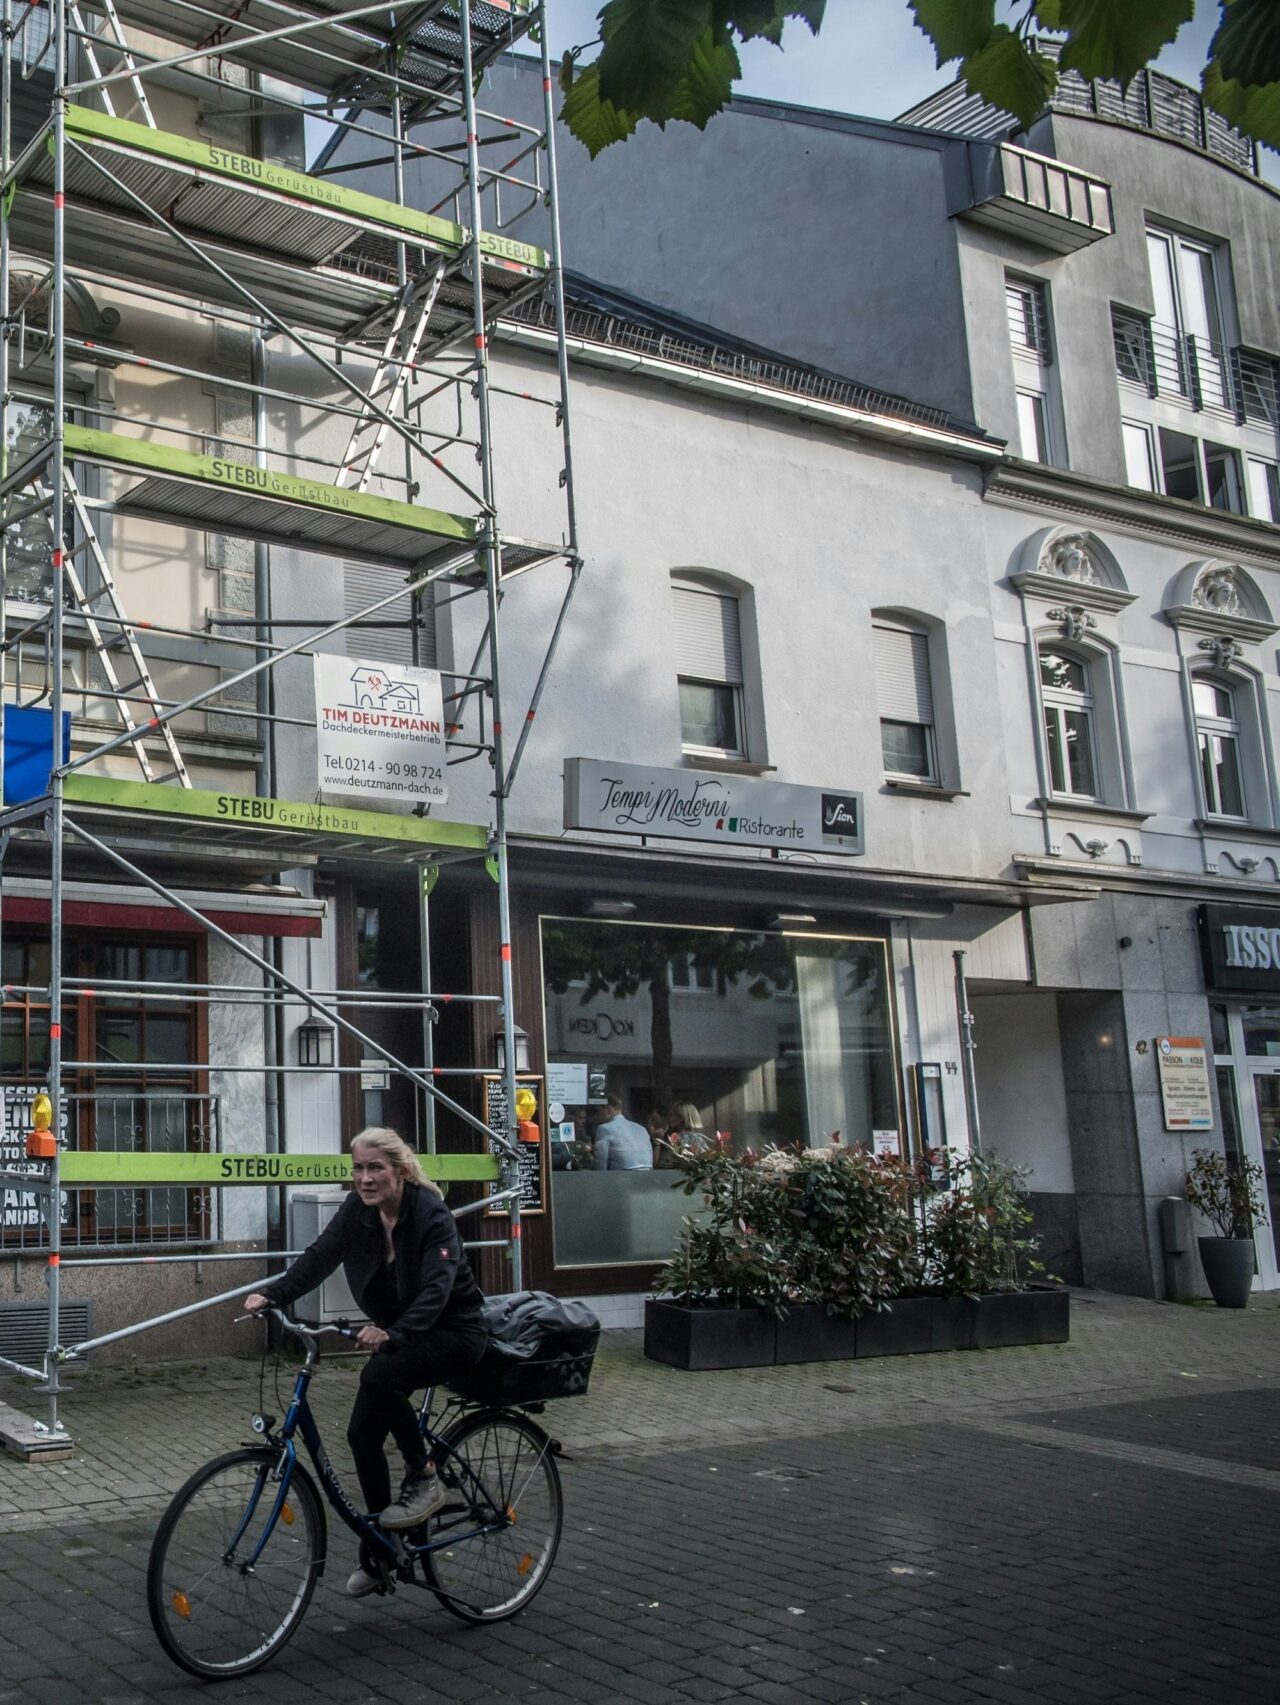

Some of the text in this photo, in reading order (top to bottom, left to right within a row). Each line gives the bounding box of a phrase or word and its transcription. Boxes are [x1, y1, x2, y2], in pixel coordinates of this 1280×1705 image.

[209, 149, 341, 203] STEBU Gerüstbau
[488, 236, 531, 262] STEBU
[212, 461, 267, 488] STEBU
[322, 721, 441, 744] Dachdeckermeisterbetrieb
[323, 708, 440, 733] TIM DEUTZMANN
[385, 762, 400, 776] 90
[403, 765, 418, 778] 98
[421, 766, 442, 780] 724
[324, 775, 443, 796] www.deutzmann-dach.de
[217, 796, 358, 831] STEBU Gerüstbau
[600, 778, 731, 827] Tempi Moderni
[738, 817, 804, 839] Ristorante
[221, 1158, 354, 1178] STEBU Gerüstb
